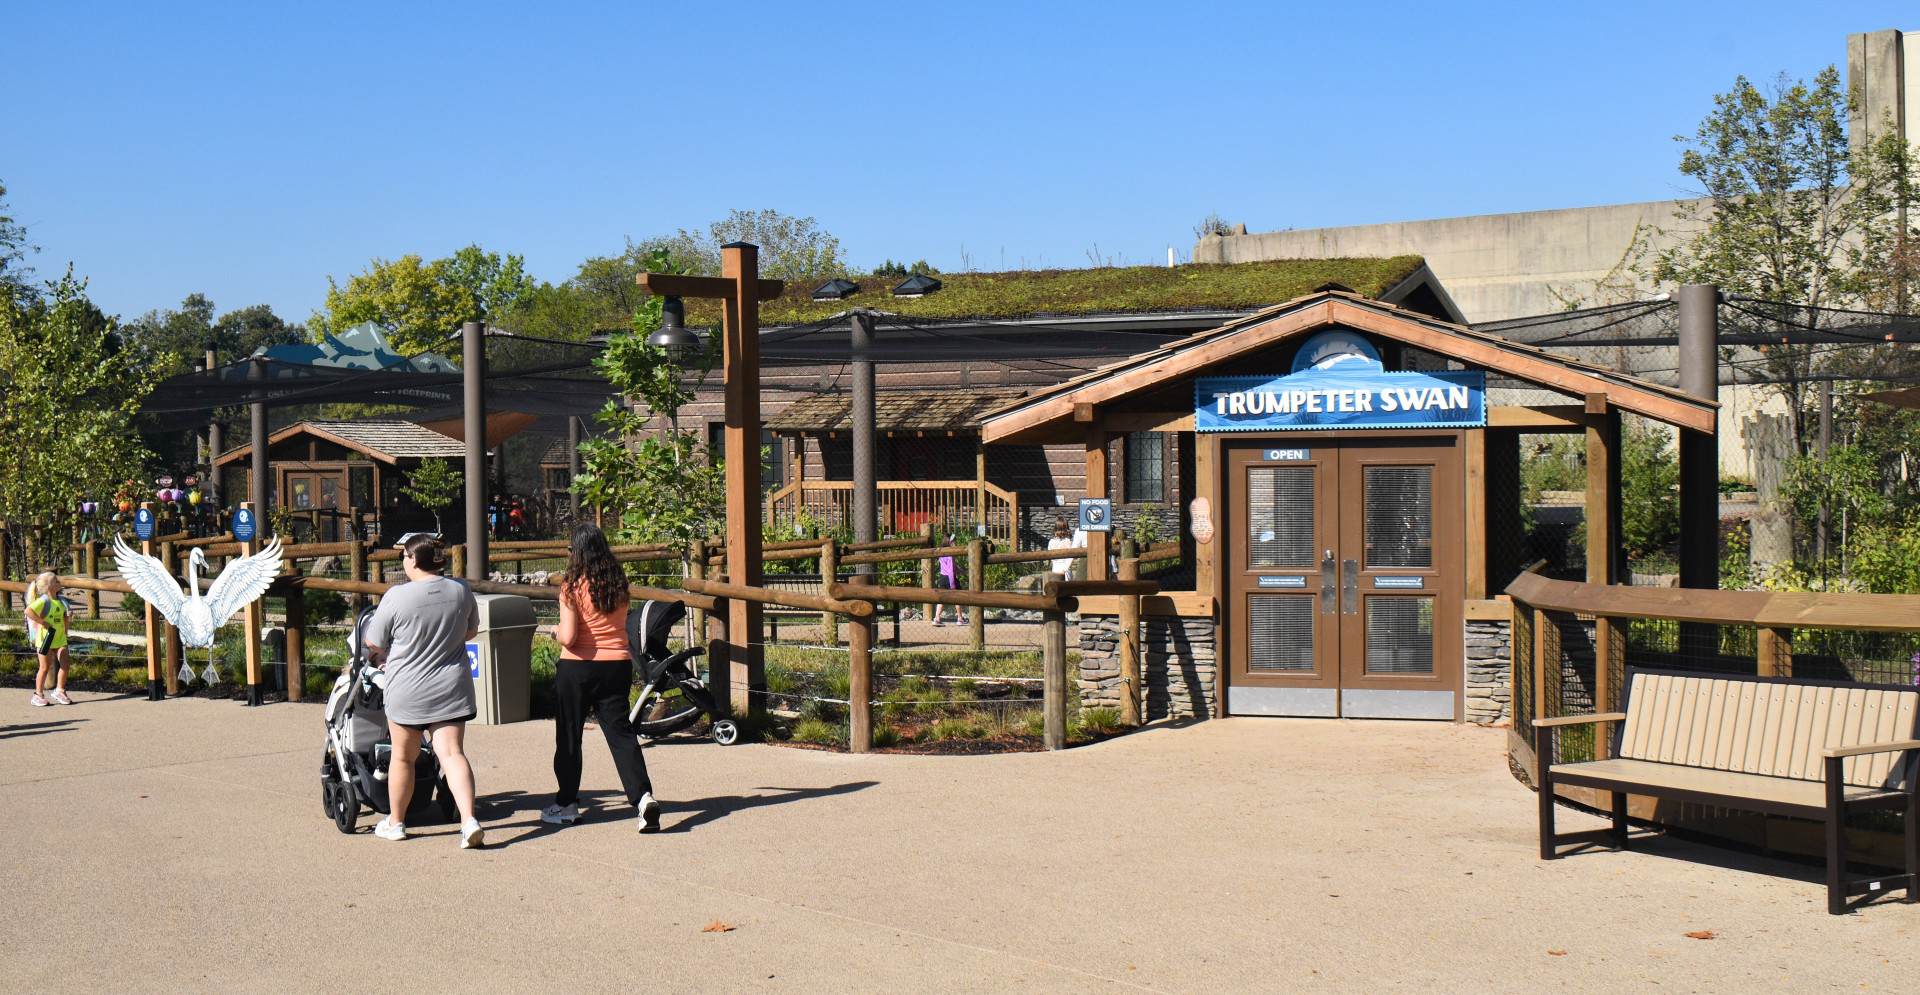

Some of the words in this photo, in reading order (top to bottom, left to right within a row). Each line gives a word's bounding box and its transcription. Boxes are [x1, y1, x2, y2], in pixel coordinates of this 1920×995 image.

[1212, 389, 1373, 415] TRUMPETER
[1379, 385, 1469, 412] SWAN
[1270, 450, 1303, 460] OPEN
